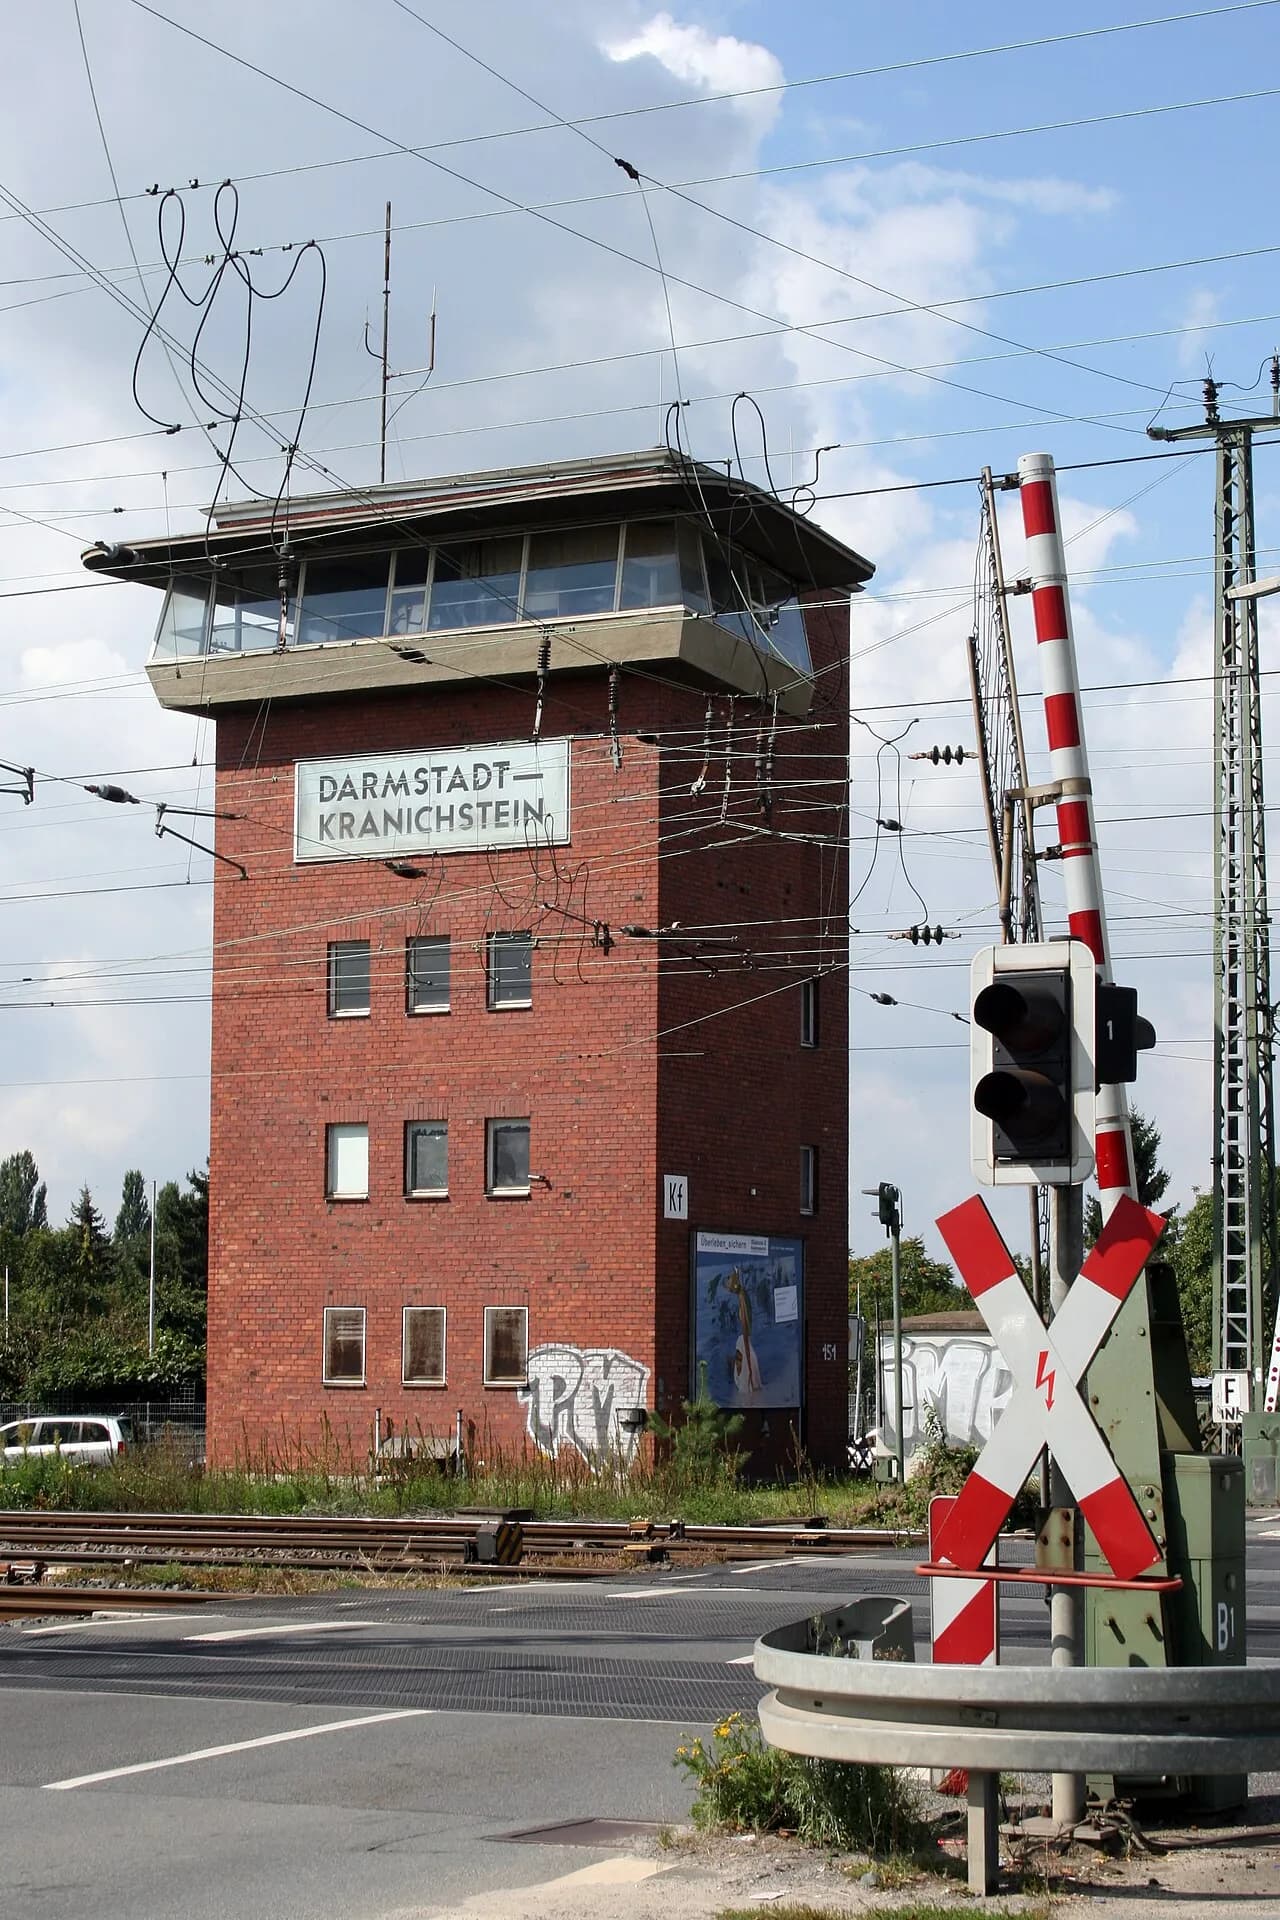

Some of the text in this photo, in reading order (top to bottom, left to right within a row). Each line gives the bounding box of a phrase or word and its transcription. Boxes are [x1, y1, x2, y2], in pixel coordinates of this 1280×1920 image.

[319, 797, 545, 842] KRANICHSTEIN
[1106, 1019, 1113, 1041] 1
[669, 1182, 683, 1212] Kf
[822, 1343, 836, 1361] 151
[1224, 1378, 1236, 1404] F
[1217, 1602, 1235, 1651] B1
